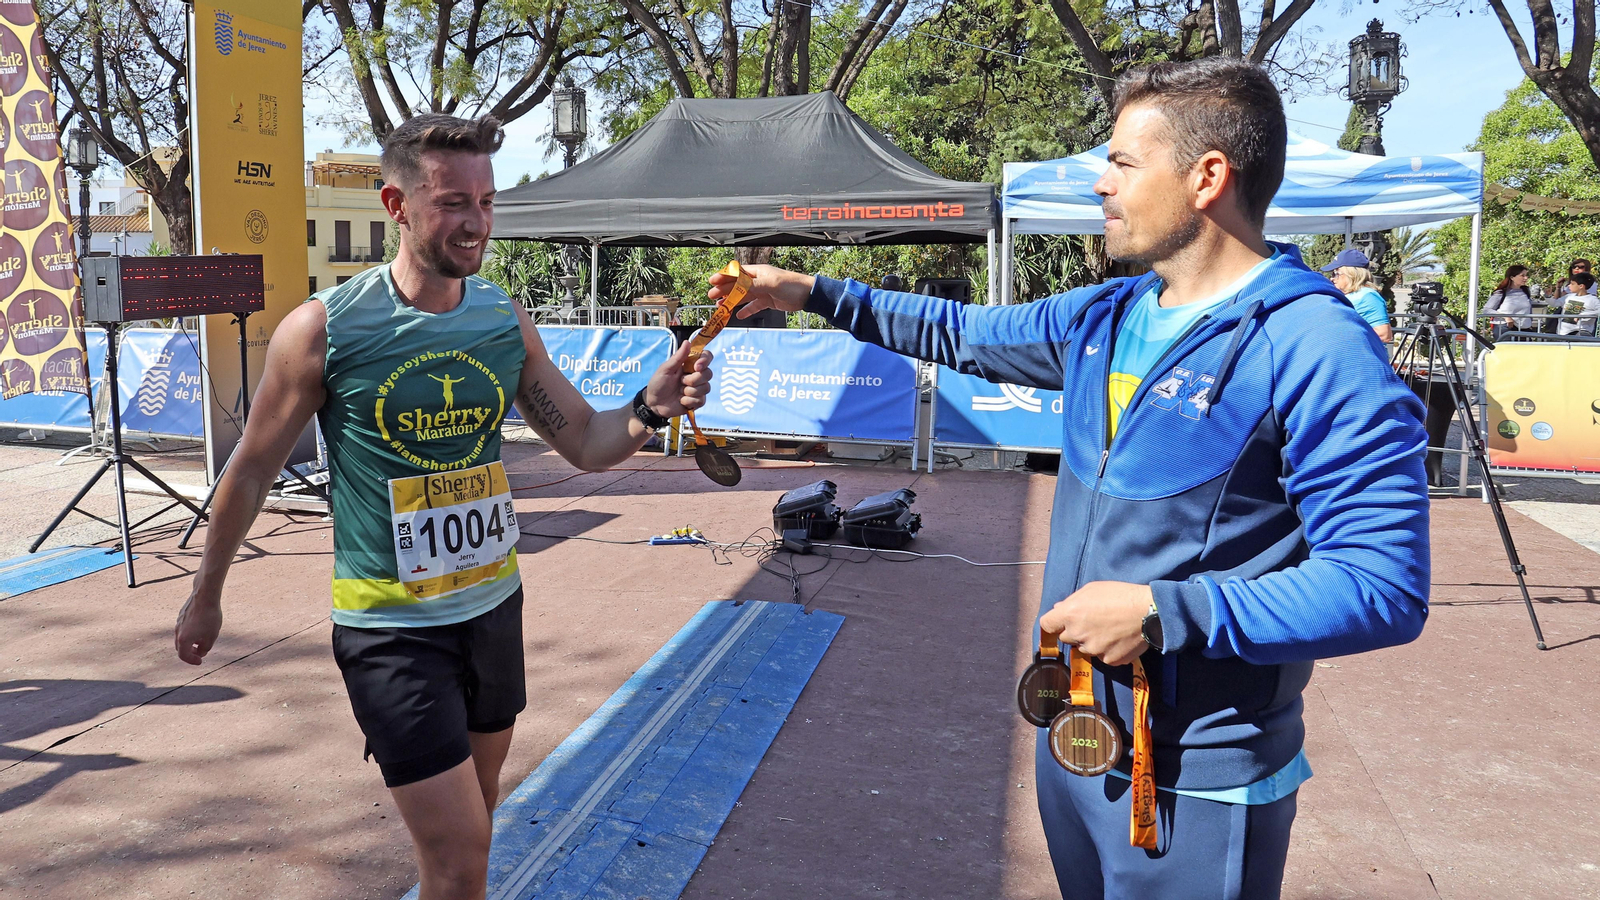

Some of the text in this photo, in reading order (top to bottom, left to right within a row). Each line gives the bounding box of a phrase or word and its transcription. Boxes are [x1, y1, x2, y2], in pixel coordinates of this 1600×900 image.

[237, 40, 266, 54] de Jerez
[238, 29, 287, 50] Ayuntamiento
[237, 160, 271, 178] HSN
[247, 339, 270, 348] COVIJER
[558, 353, 642, 374] Diputación
[176, 371, 201, 388] Ayu
[377, 349, 500, 396] #yosoysherryrunner
[769, 369, 883, 387] Ayuntamiento
[174, 387, 203, 404] de Je
[580, 378, 625, 397] Cádiz
[768, 385, 831, 402] de Jerez
[528, 380, 569, 431] MMXIV
[397, 407, 492, 432] Sherry
[415, 423, 474, 442] Maratón
[431, 473, 487, 496] Sherry
[453, 488, 480, 502] Media
[420, 503, 505, 558] 1004
[458, 552, 476, 562] Jerry
[455, 561, 480, 571] Aguilera
[1075, 670, 1090, 678] 2023
[1037, 689, 1059, 699] 2023
[1071, 737, 1099, 749] 2023
